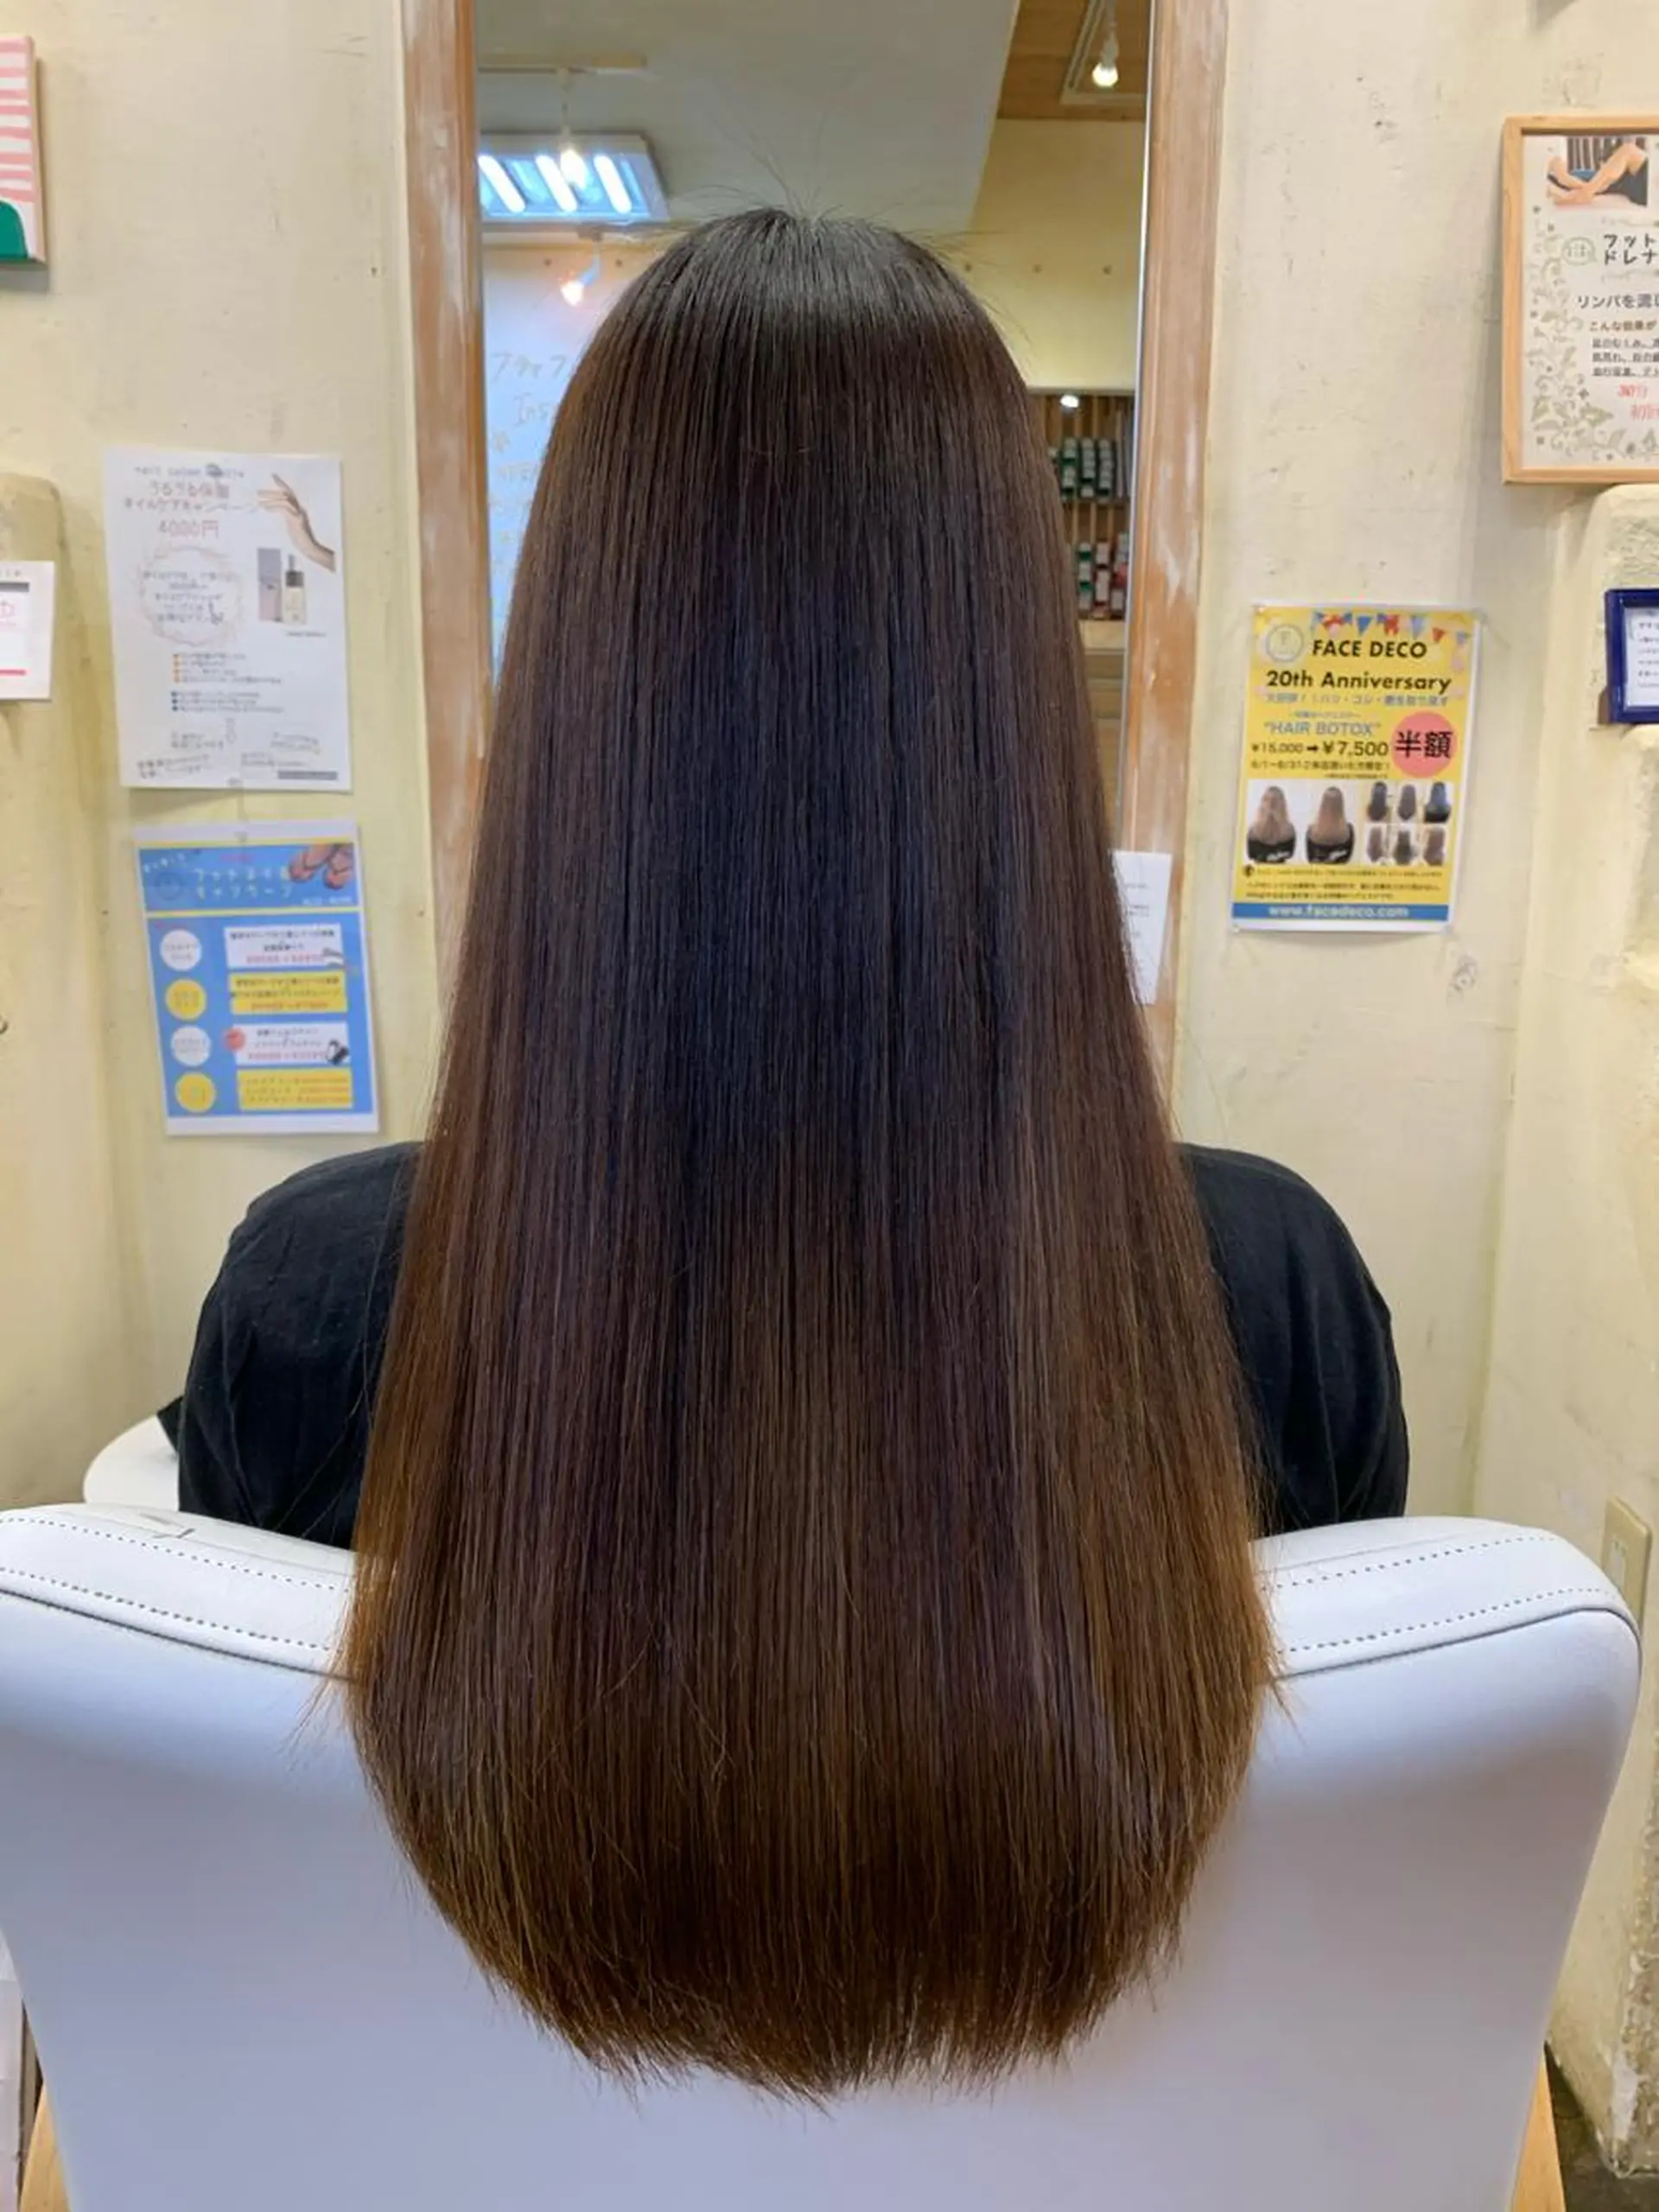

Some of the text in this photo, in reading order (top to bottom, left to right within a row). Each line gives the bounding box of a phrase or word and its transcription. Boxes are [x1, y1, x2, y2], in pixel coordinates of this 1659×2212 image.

[1312, 639, 1427, 658] FACE DECO
[1266, 670, 1452, 696] 20th Anniversary
[1395, 729, 1453, 759] 半額
